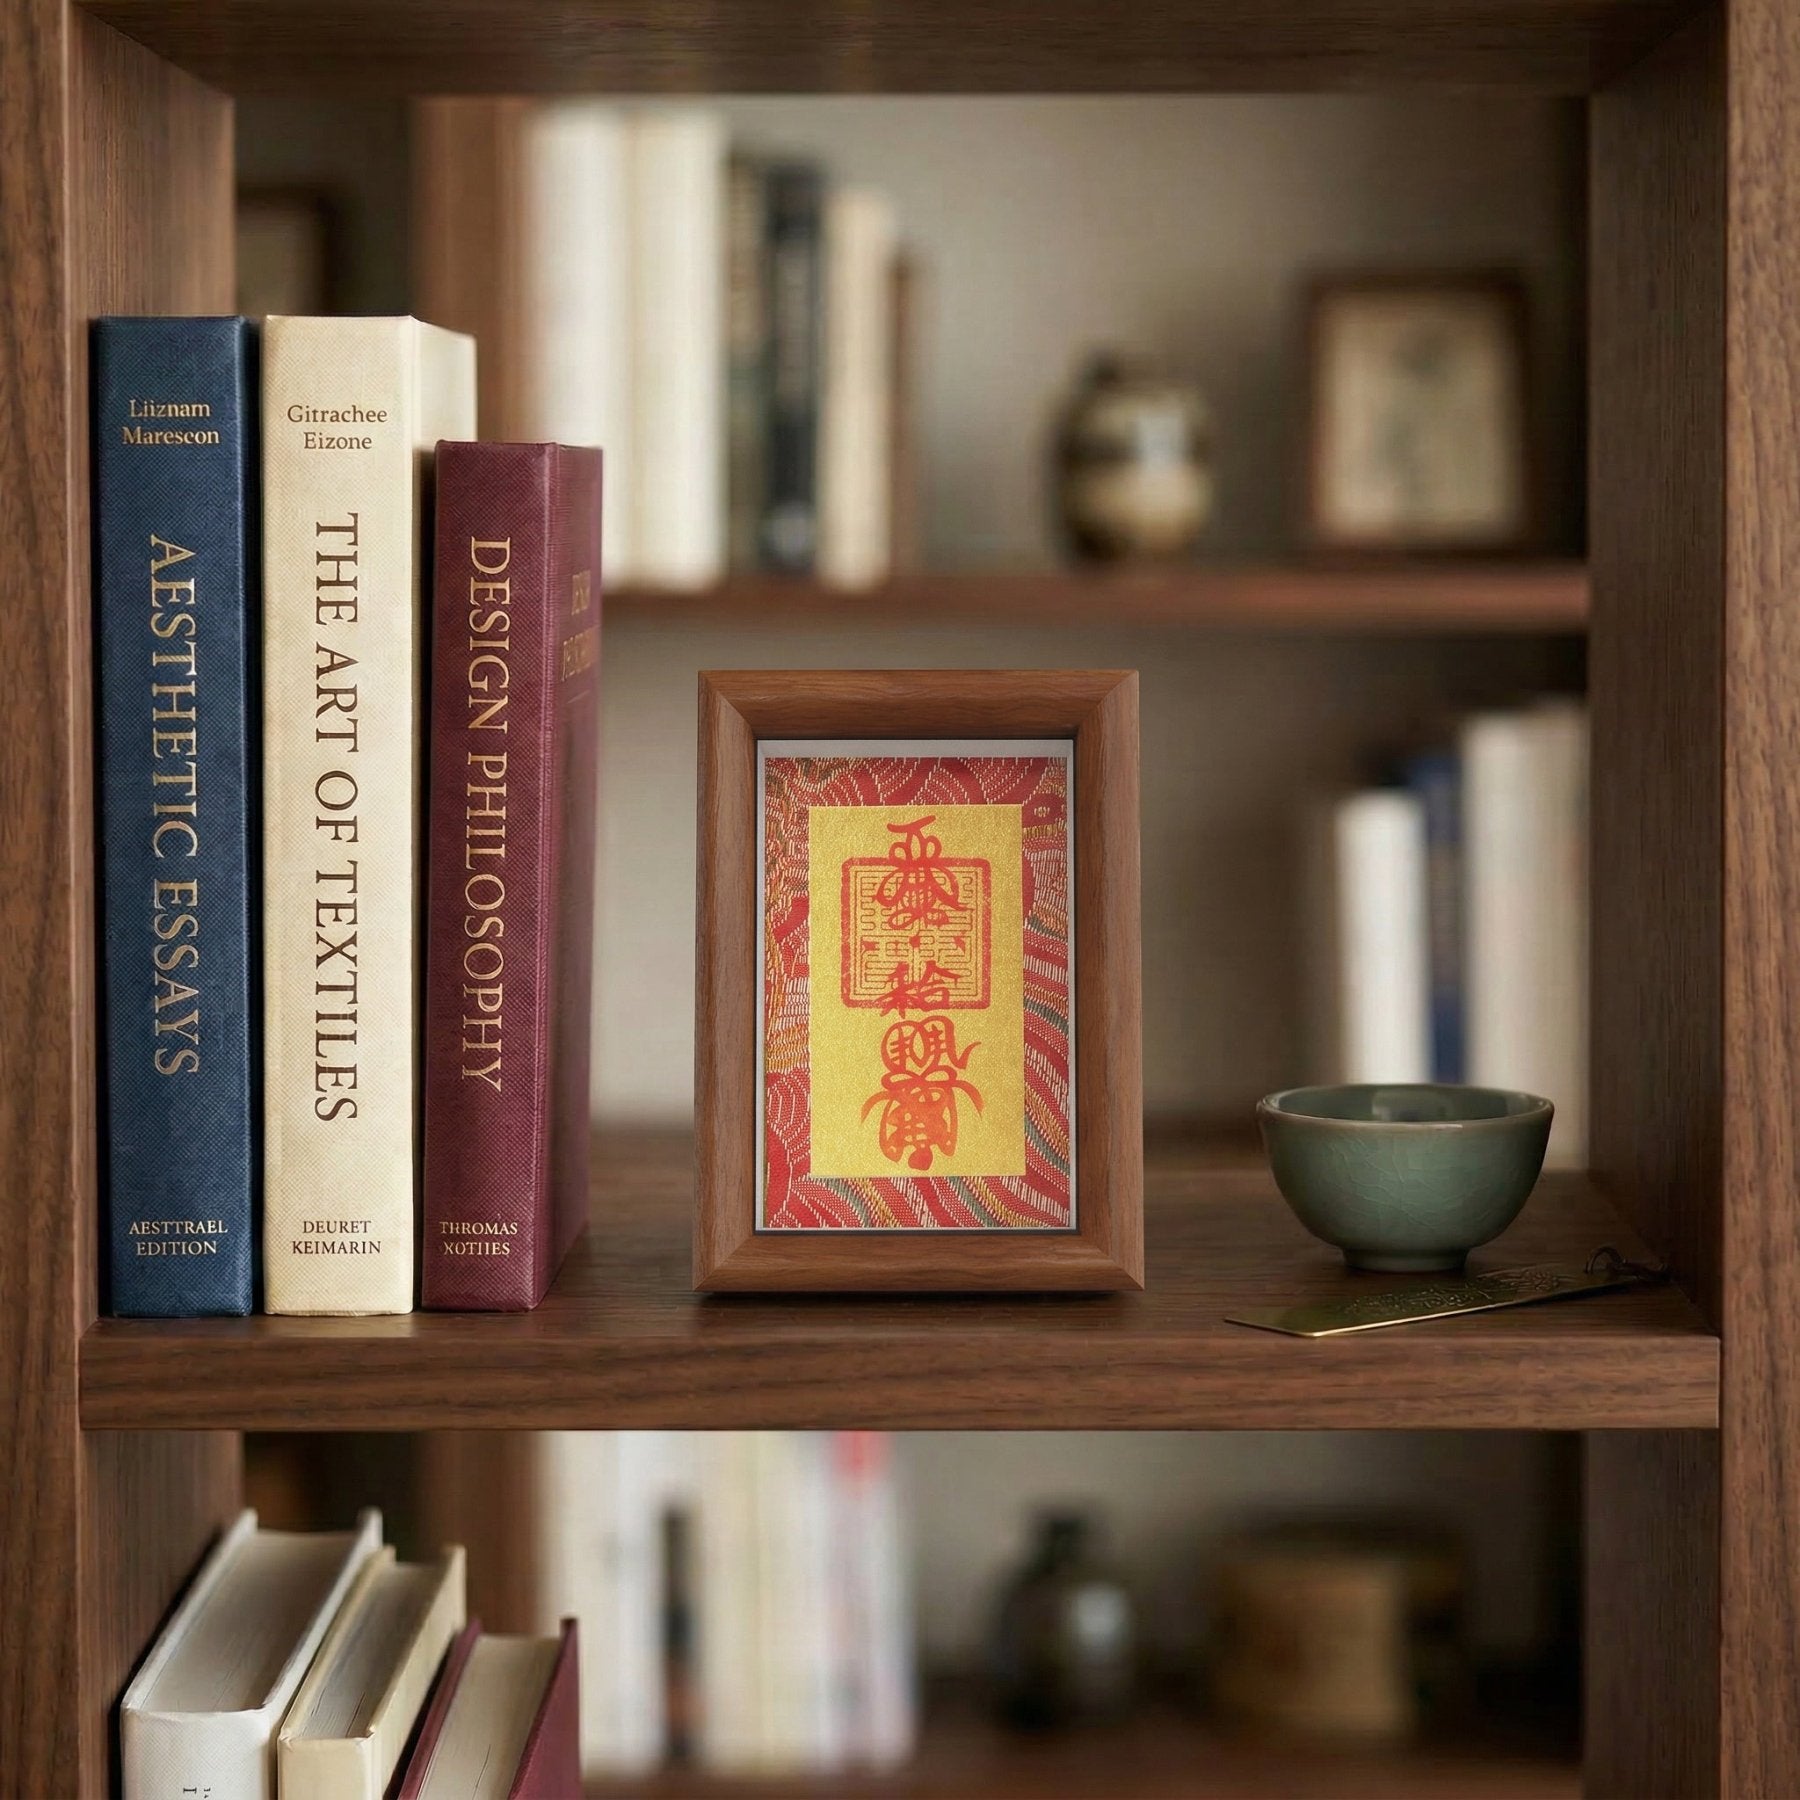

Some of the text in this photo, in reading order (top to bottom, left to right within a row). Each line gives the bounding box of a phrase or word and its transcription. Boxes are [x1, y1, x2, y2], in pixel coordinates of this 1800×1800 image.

[287, 405, 388, 422] Gitrachee
[122, 426, 220, 444] Marescon
[303, 431, 372, 449] Eizone
[150, 533, 200, 1075] AESTHETIC ESSAYS
[314, 511, 359, 1122] THE ART OF TEXTILES
[462, 535, 511, 1093] DESIGN PHILOSOPHY
[128, 1220, 229, 1235] AESTTRAEL
[302, 1220, 372, 1234] DEURET
[136, 1240, 217, 1256] EDITION
[292, 1240, 381, 1254] KEIMARIN
